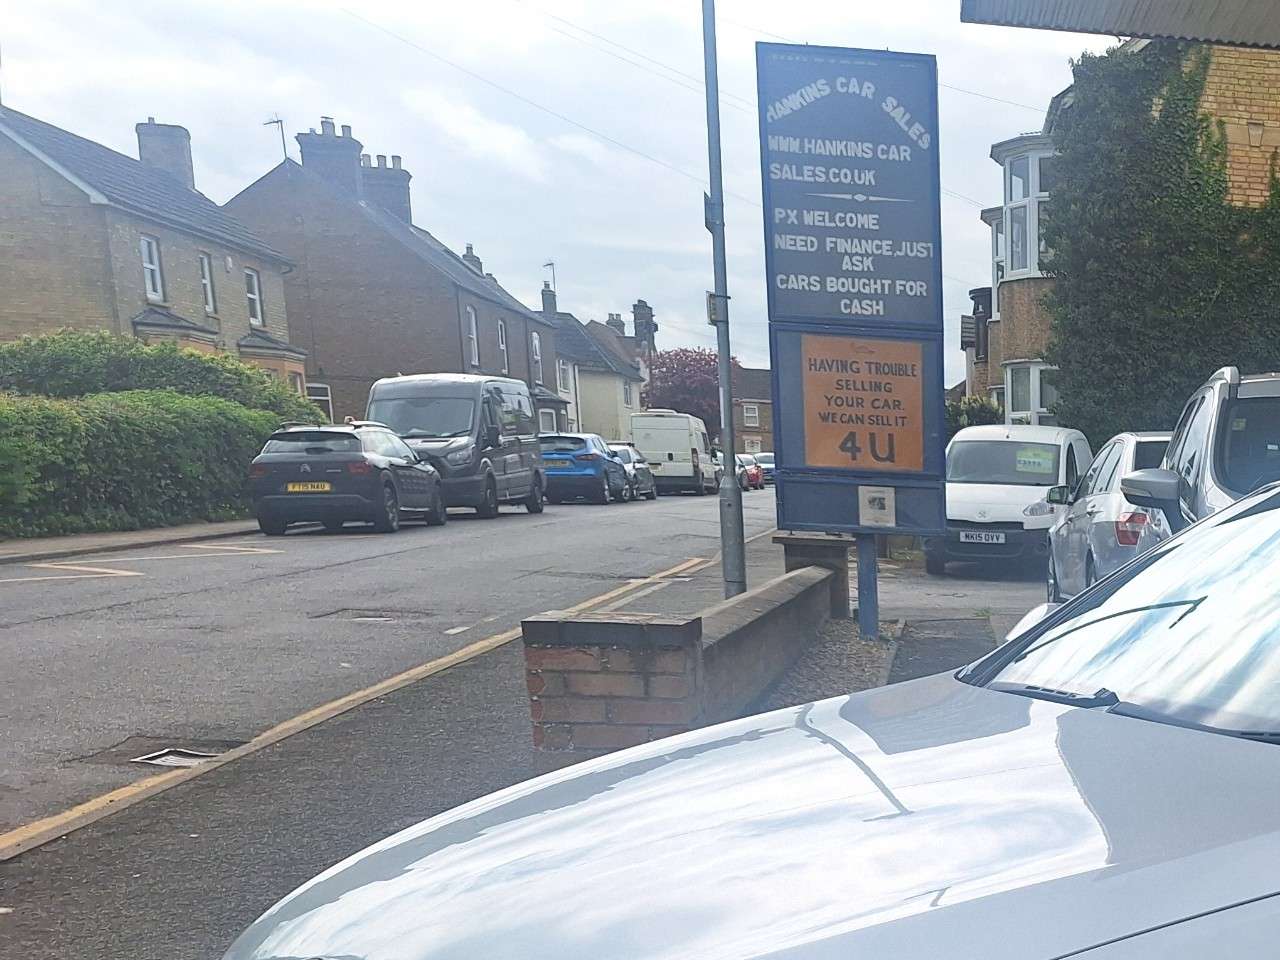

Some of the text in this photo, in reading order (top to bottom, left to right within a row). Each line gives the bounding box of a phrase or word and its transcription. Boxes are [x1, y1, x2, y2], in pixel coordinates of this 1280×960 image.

[766, 76, 931, 149] HANKINS CAR SALES
[877, 144, 911, 161] CAR
[769, 163, 876, 185] SALES.CO.UK
[774, 208, 879, 229] PX WELCOME
[774, 234, 818, 251] NEED
[842, 255, 874, 271] ASK
[777, 274, 927, 296] CARS BOUGHT FOR
[841, 299, 884, 315] CASH
[808, 357, 917, 377] HAVING TROUBLE
[835, 379, 892, 393] SELLING
[824, 395, 864, 408] YOUR
[818, 411, 907, 426] WE CAN SELL IT
